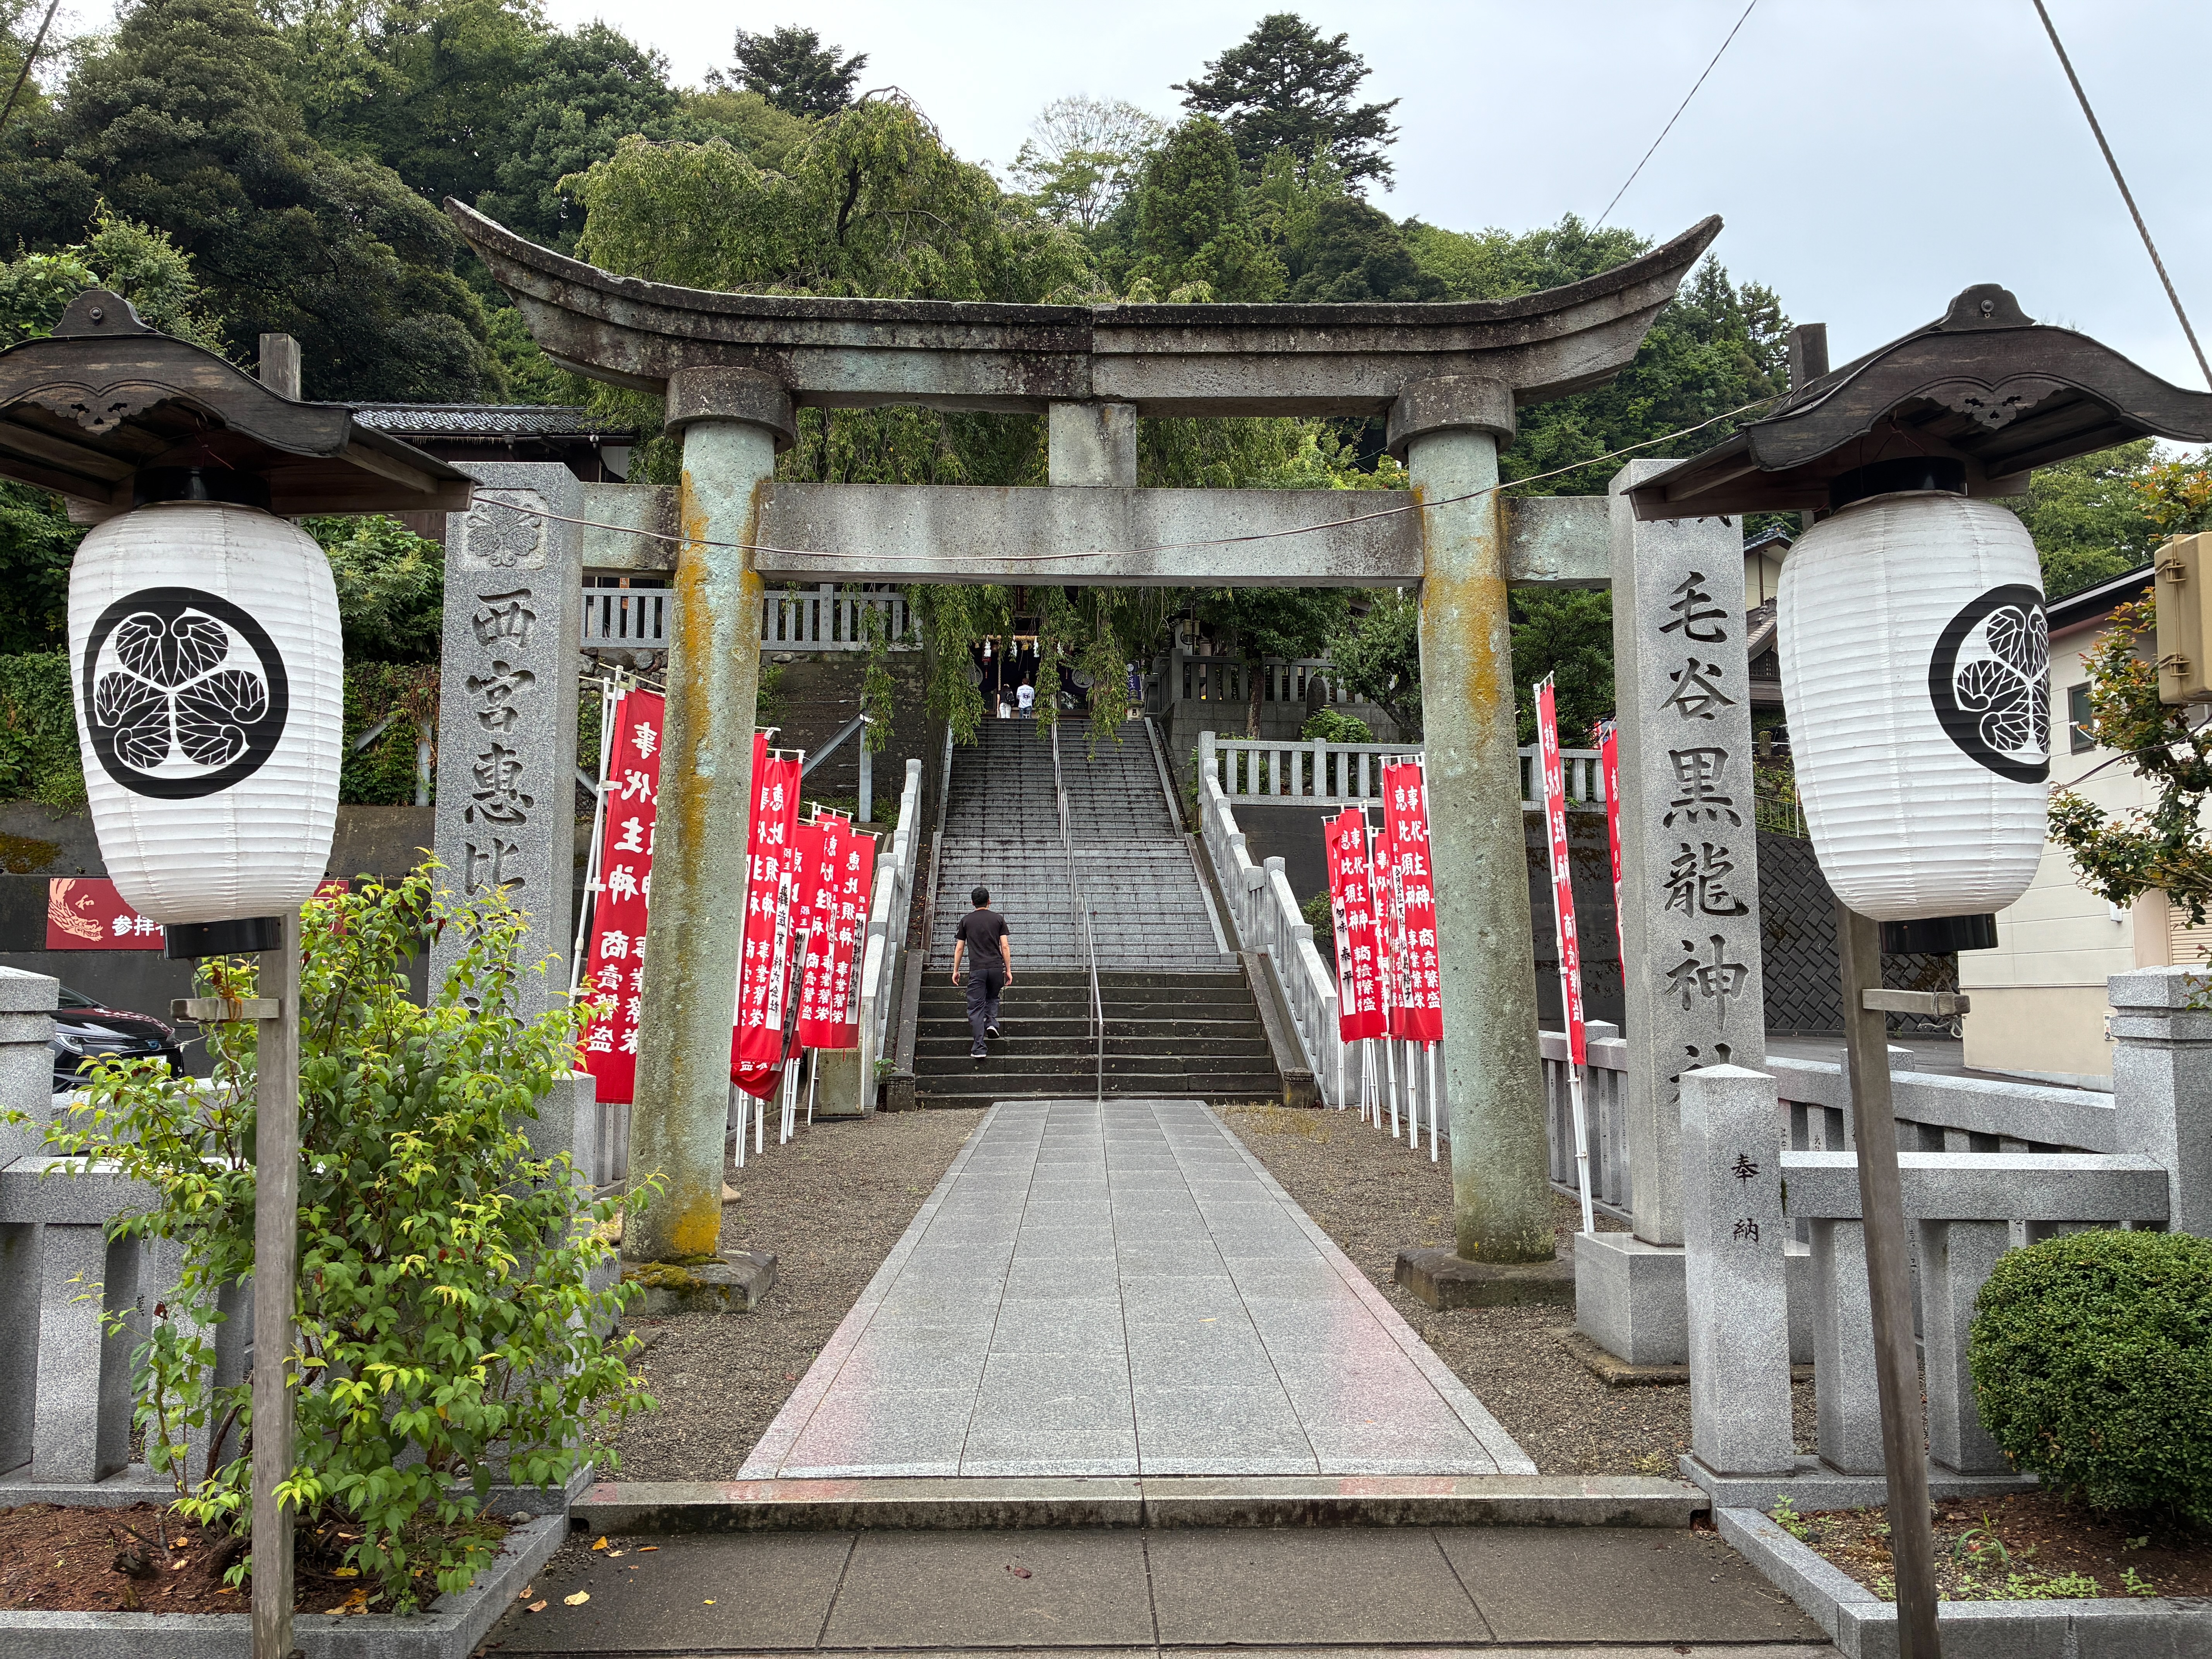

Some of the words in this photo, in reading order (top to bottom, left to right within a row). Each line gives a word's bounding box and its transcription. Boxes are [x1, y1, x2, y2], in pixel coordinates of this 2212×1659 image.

[1395, 785, 1415, 912] 恵比須神
[1407, 785, 1430, 912] 事代主神
[1650, 516, 1750, 1104] 毛谷黒龍神
[75, 894, 95, 911] 和
[1350, 827, 1369, 932] 事代主神
[1340, 946, 1354, 986] 泰平
[1360, 945, 1377, 1012] 商賣繁盛
[1407, 928, 1425, 1009] 事業繁栄
[1419, 927, 1440, 1009] 商賣繁盛
[1729, 1154, 1760, 1243] 奉納
